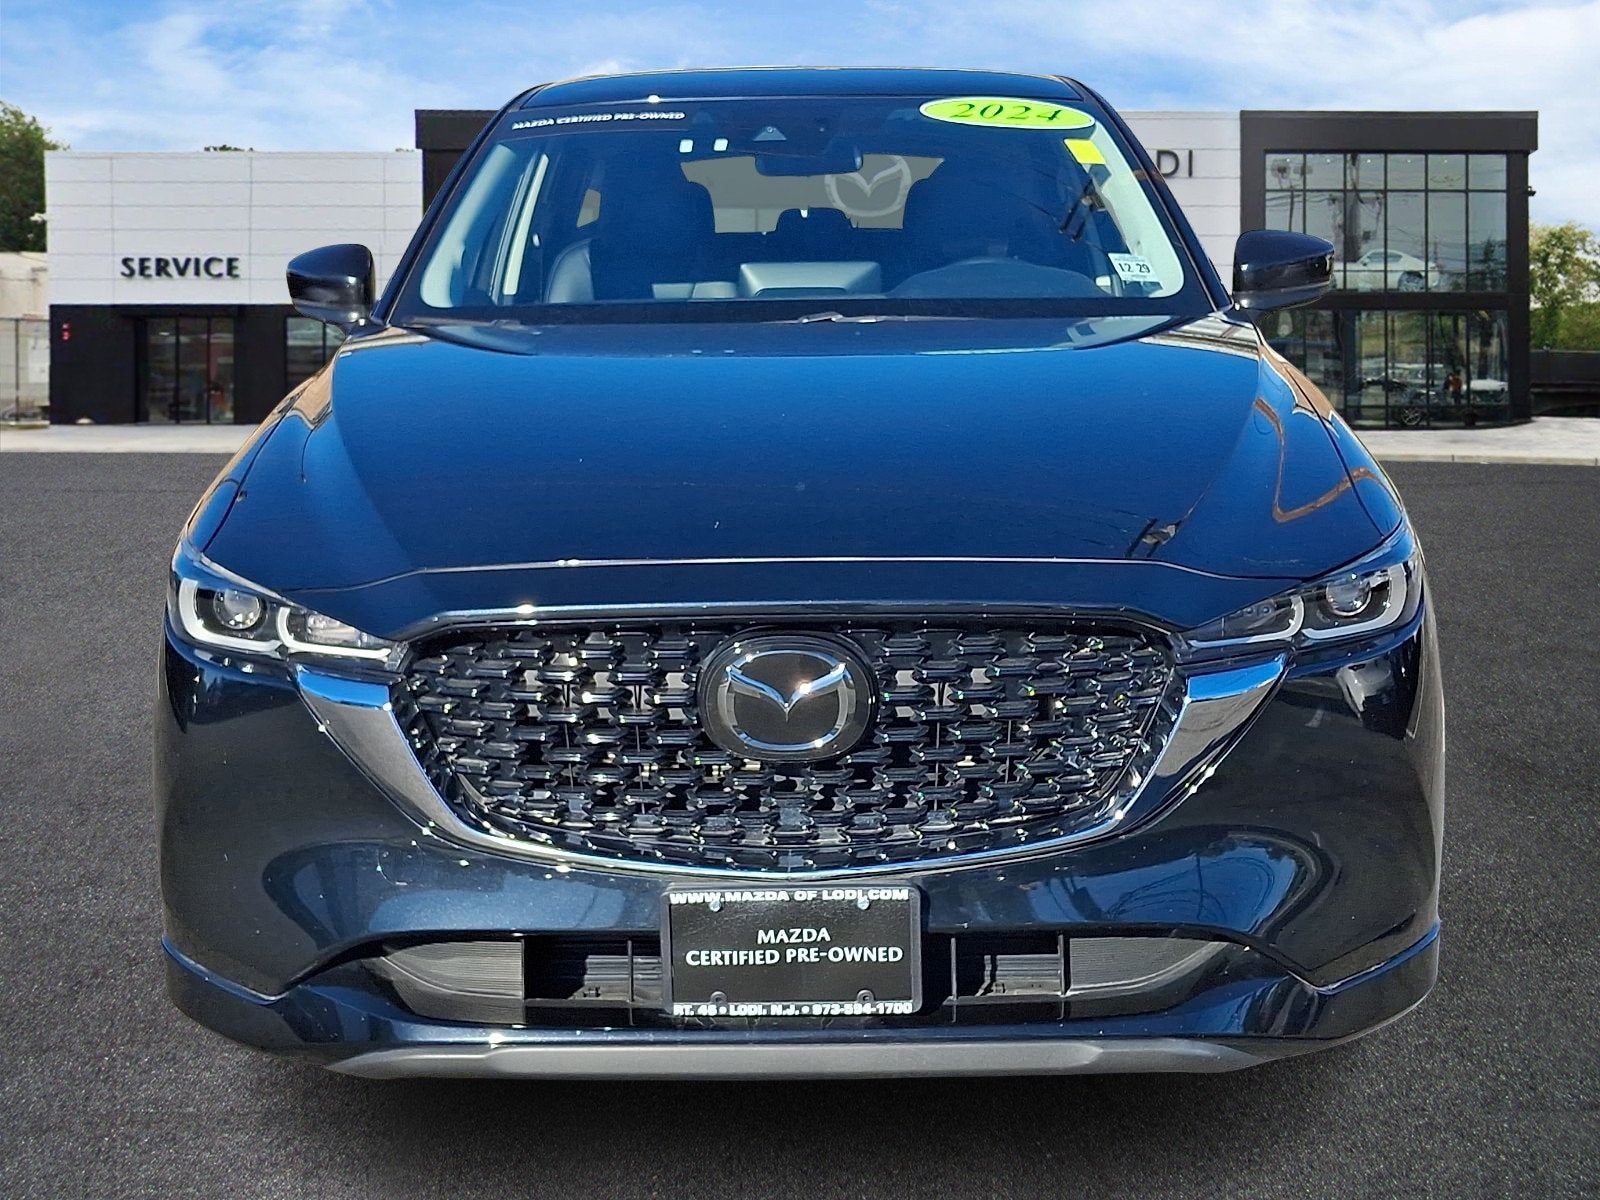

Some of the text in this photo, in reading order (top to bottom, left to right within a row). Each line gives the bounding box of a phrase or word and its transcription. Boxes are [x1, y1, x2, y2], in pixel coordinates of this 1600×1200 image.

[950, 103, 1063, 122] 2024
[512, 118, 555, 130] MAZDA
[120, 256, 241, 278] SERVICE
[793, 890, 818, 901] OF
[757, 927, 831, 945] MAZDA
[685, 946, 904, 967] CERTIFIED PRE-OWNED
